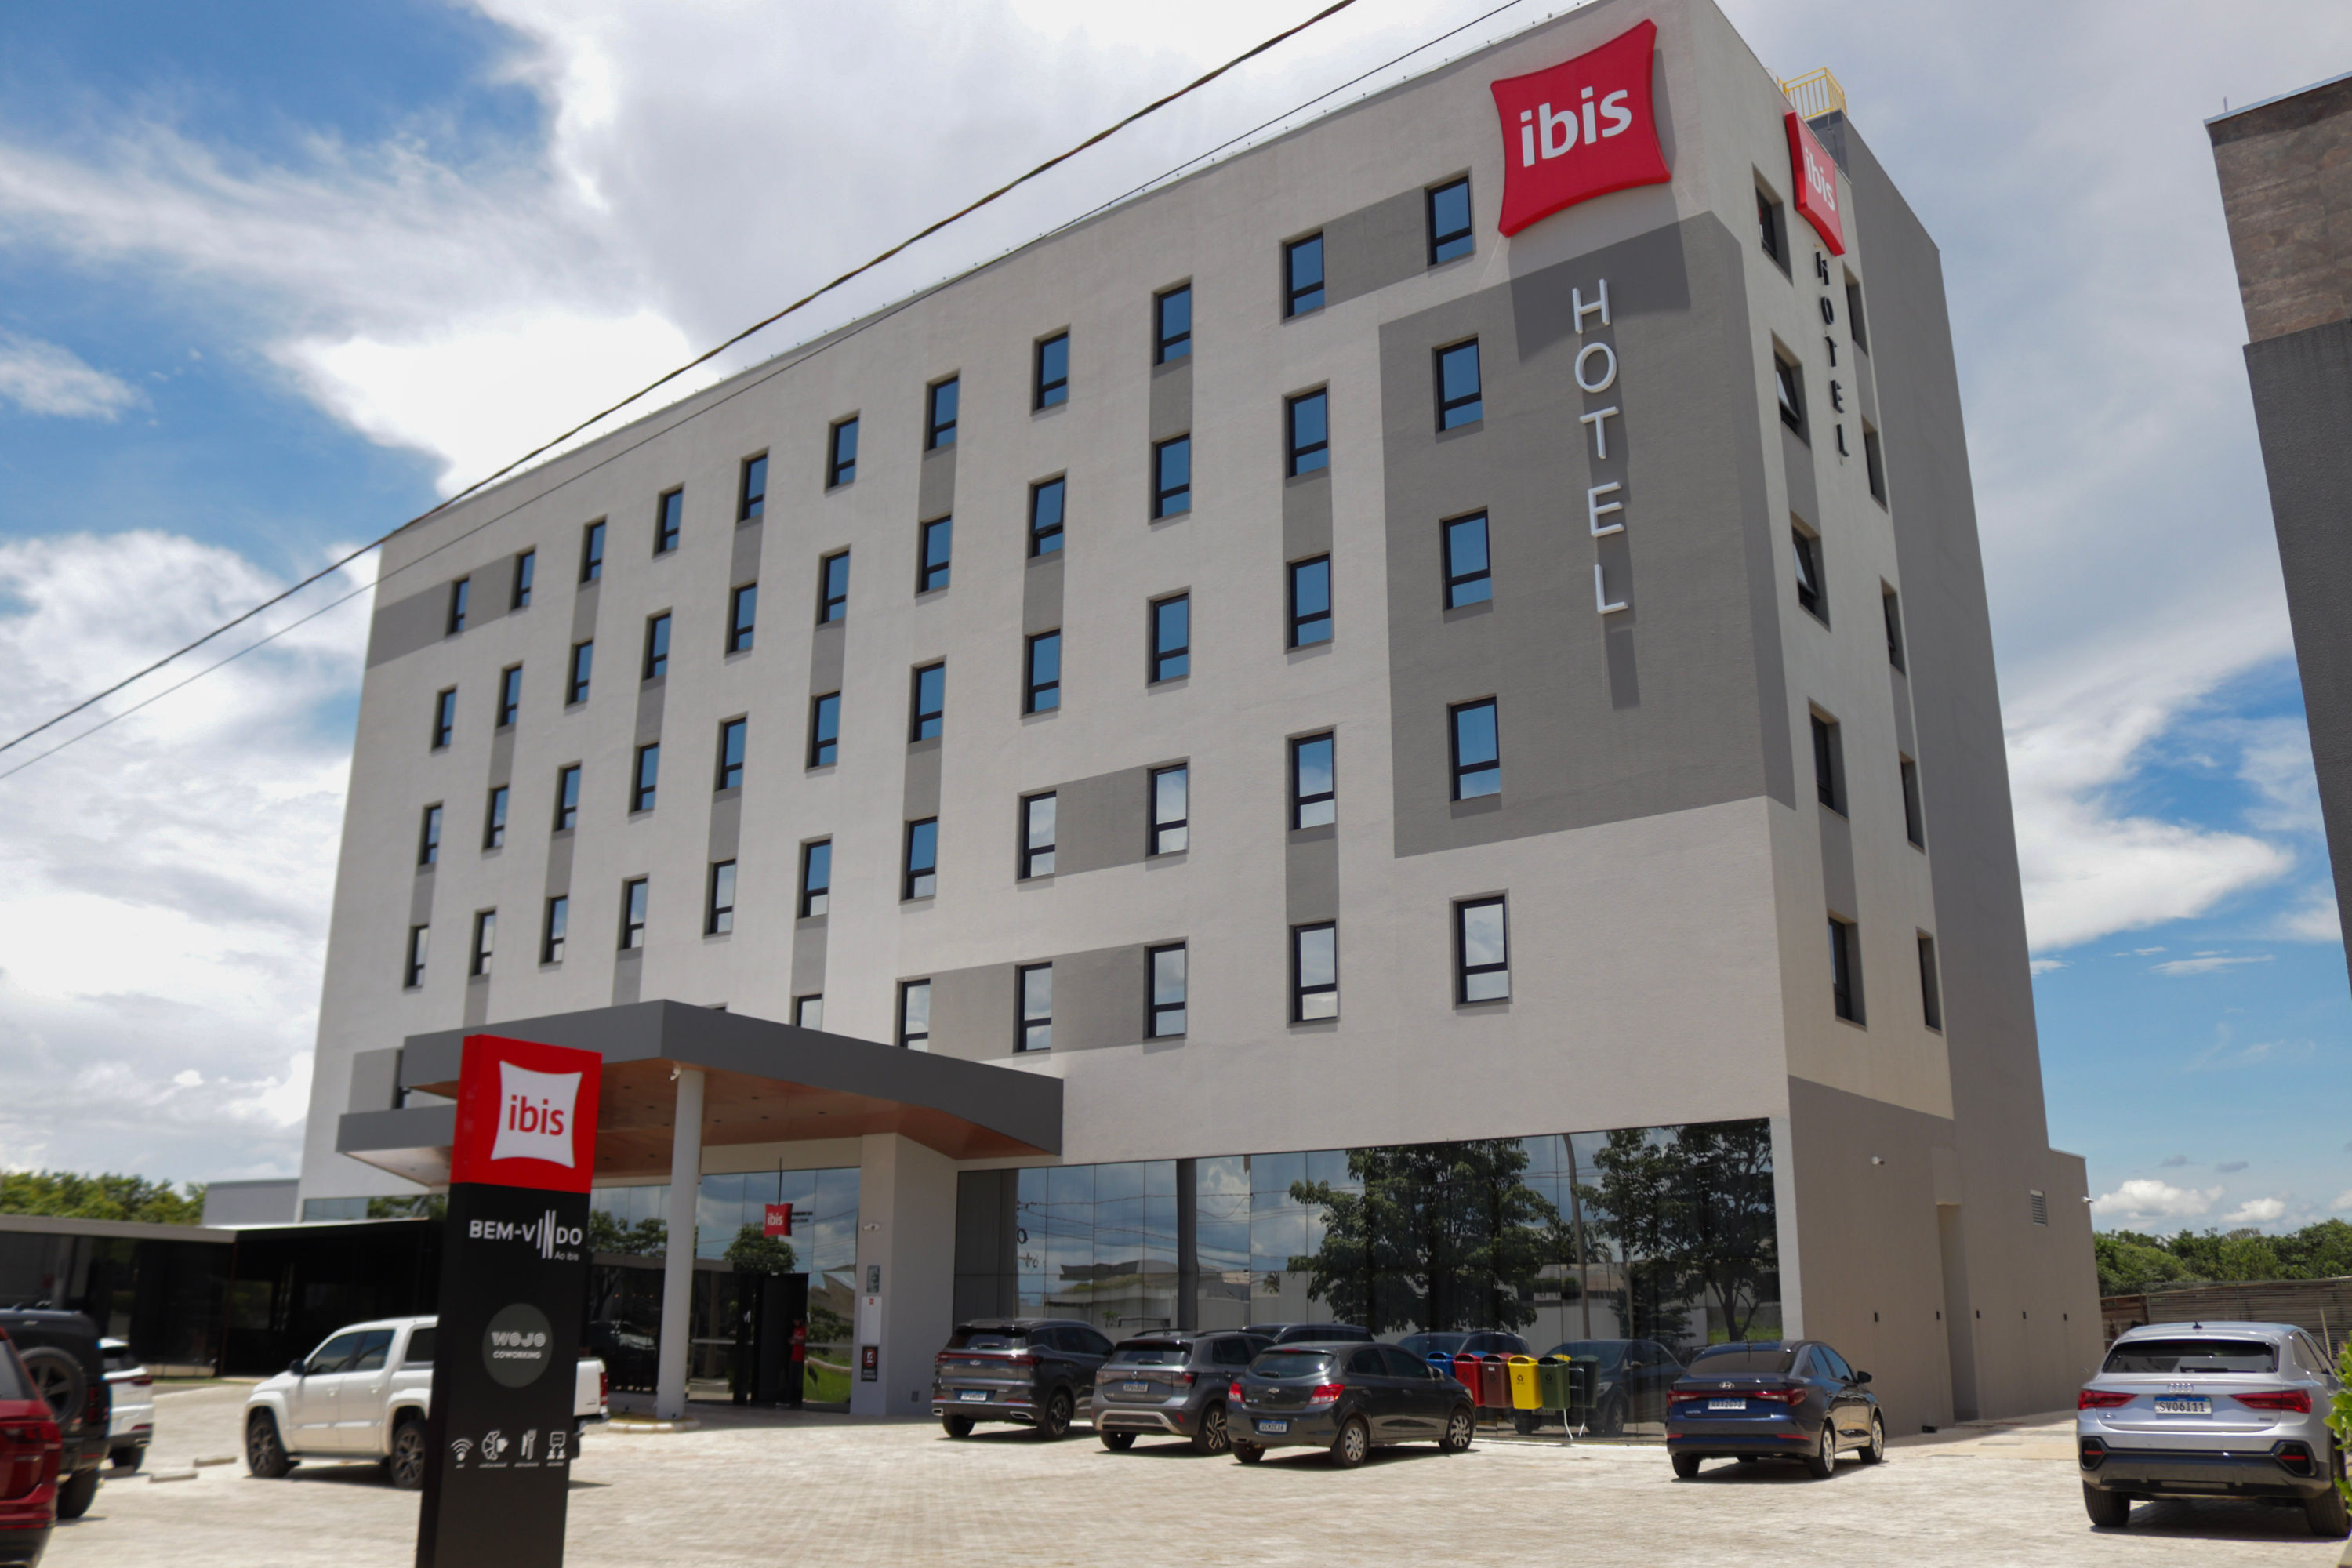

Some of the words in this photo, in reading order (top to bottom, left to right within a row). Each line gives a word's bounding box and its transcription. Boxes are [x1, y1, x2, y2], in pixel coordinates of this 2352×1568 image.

[1519, 85, 1632, 168] ibis
[1804, 146, 1835, 211] ibis
[1815, 251, 1849, 457] HOTEL
[1572, 278, 1628, 615] HOTEL
[508, 1094, 564, 1136] ibis
[767, 1212, 783, 1226] ibis
[491, 1331, 546, 1348] WOJO
[492, 1350, 542, 1359] COWORKING
